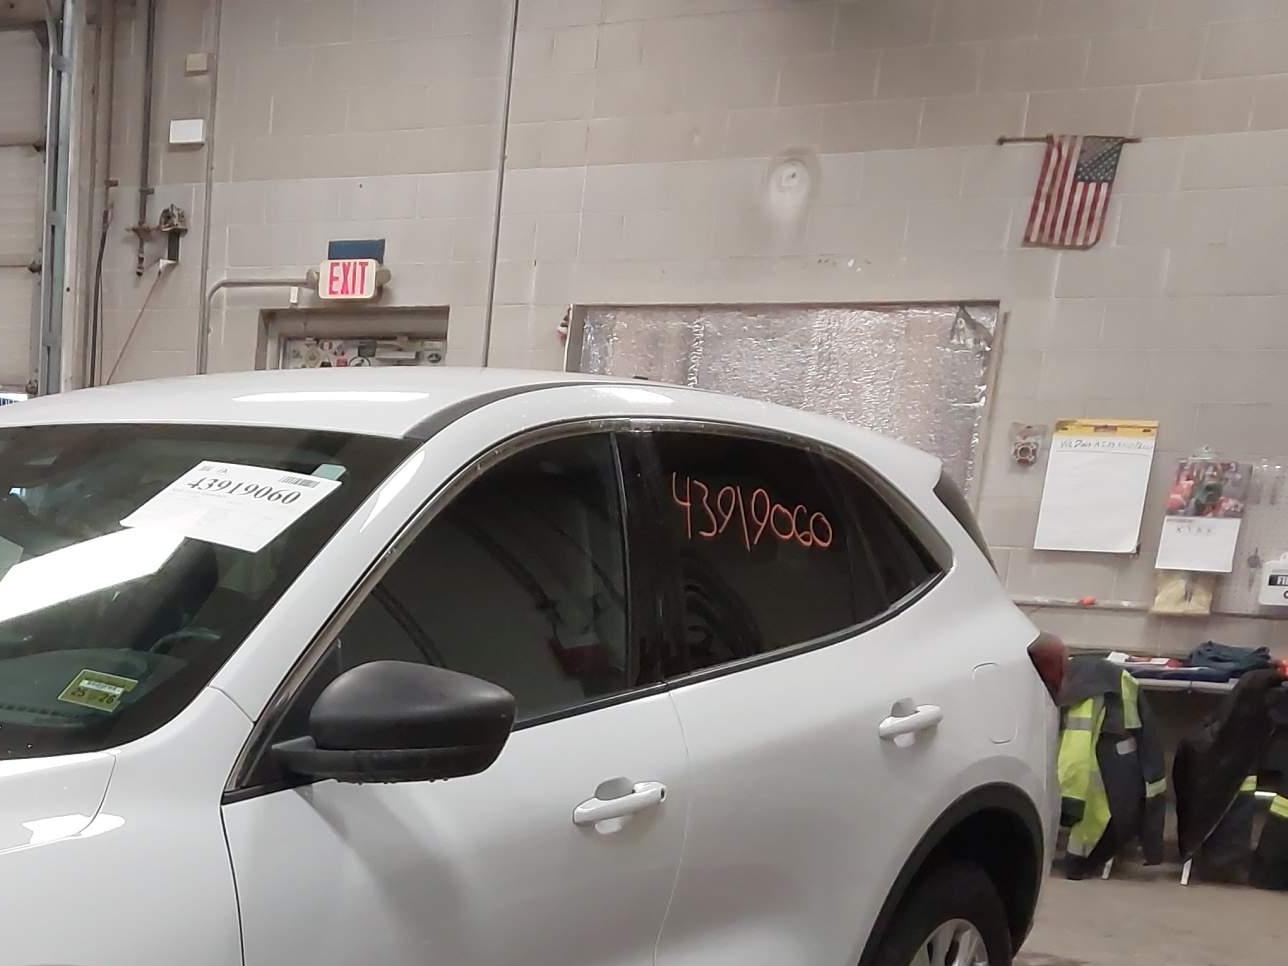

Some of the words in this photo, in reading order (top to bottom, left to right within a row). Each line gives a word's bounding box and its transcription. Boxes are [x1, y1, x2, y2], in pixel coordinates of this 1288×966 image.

[328, 261, 368, 295] EXIT
[187, 477, 302, 505] 43919060
[673, 472, 832, 552] 43919060
